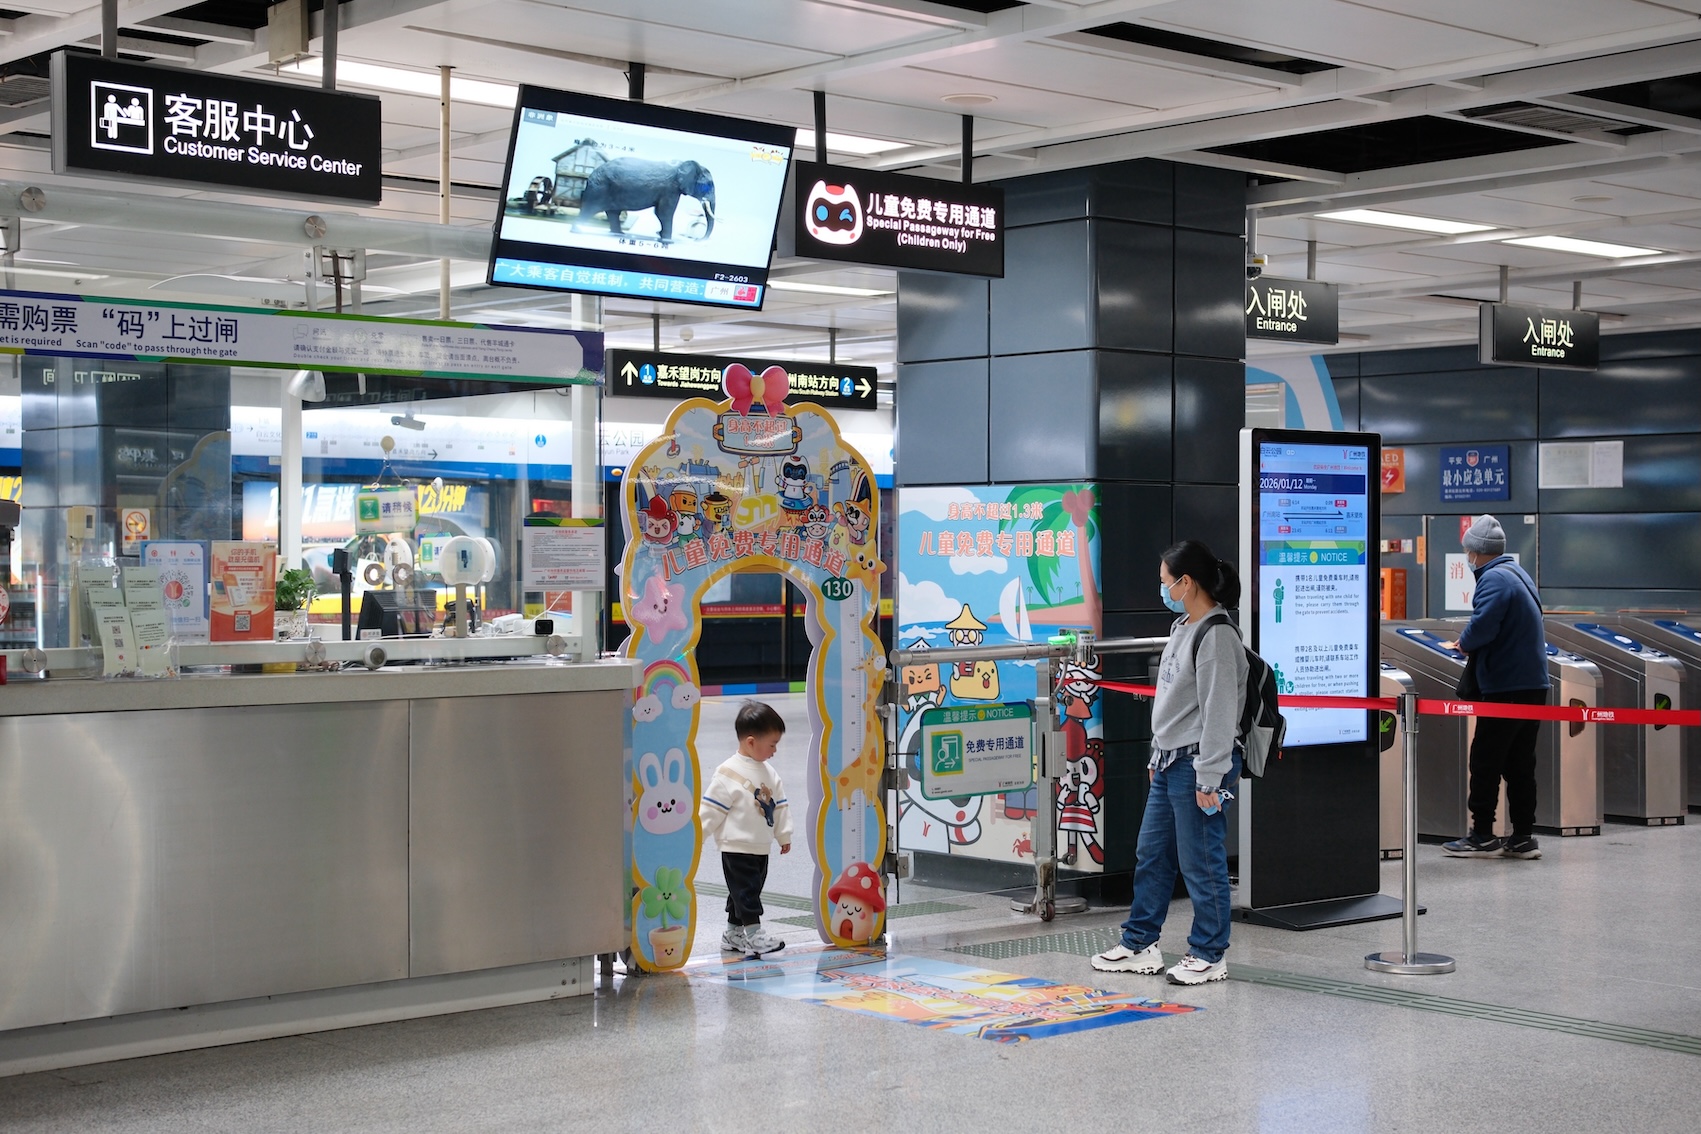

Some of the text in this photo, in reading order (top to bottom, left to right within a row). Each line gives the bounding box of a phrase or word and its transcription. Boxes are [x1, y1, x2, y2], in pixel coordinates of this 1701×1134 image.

[163, 93, 315, 152] 客服中心
[163, 137, 362, 177] Customer Service Center
[866, 192, 996, 230] 儿童免费专用通道
[866, 215, 996, 242] Special Passageway for Free
[897, 232, 967, 253] (Children Only)
[714, 273, 749, 283] F2-2603
[1246, 286, 1308, 321] 入闸处
[0, 303, 78, 334] 需购票
[1256, 317, 1297, 332] Entrance
[1523, 317, 1574, 347] 入闸处
[11, 335, 19, 344] is
[21, 337, 62, 347] required
[76, 340, 98, 348] Scan
[144, 345, 165, 353] pass
[166, 344, 202, 356] through
[203, 347, 218, 356] the
[219, 348, 238, 358] gate
[1531, 345, 1565, 358] Entrance
[657, 364, 721, 383] 嘉禾望岗方向
[1260, 478, 1303, 490] 2026/01/12
[1443, 468, 1504, 487] 最小应急单元
[947, 501, 1044, 521] 身高不超过1.3米
[918, 530, 1076, 558] 儿童免费专用通道
[661, 530, 847, 581] 儿童免费专用通道
[1321, 552, 1348, 562] NOTICE
[1450, 561, 1464, 580] 消
[824, 580, 850, 597] 130
[943, 709, 977, 723] 温馨提示
[986, 708, 1014, 718] NOTICE
[966, 736, 1025, 754] 免费专用通道
